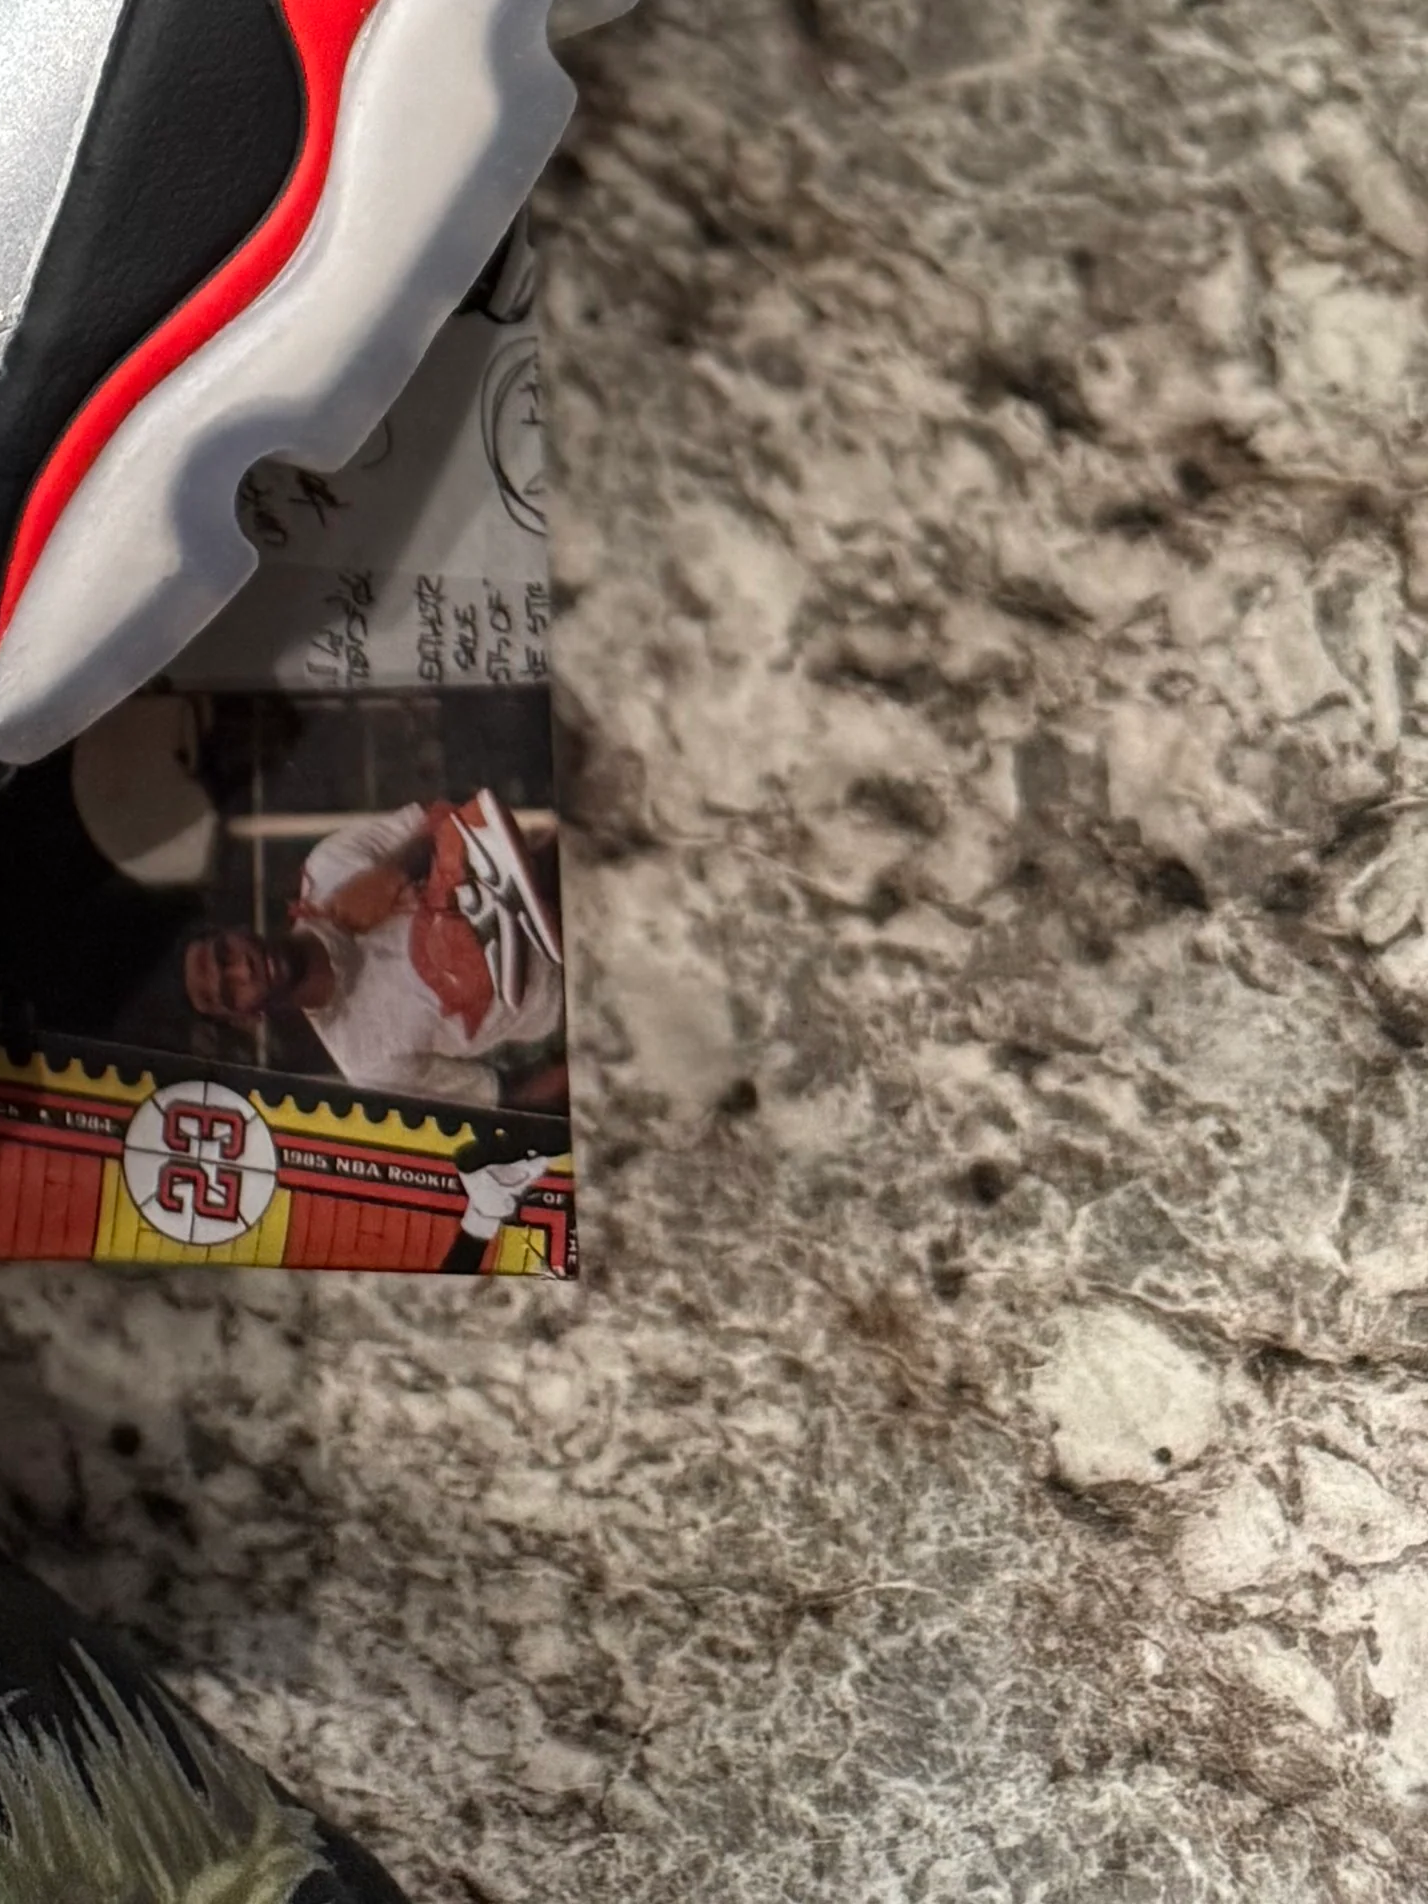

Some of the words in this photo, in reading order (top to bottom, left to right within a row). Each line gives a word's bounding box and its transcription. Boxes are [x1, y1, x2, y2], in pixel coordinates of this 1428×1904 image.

[158, 1099, 248, 1224] 23
[282, 1148, 328, 1168] 1985
[335, 1157, 382, 1178] NBA
[387, 1166, 460, 1191] ROOKIE
[542, 1191, 564, 1206] OF
